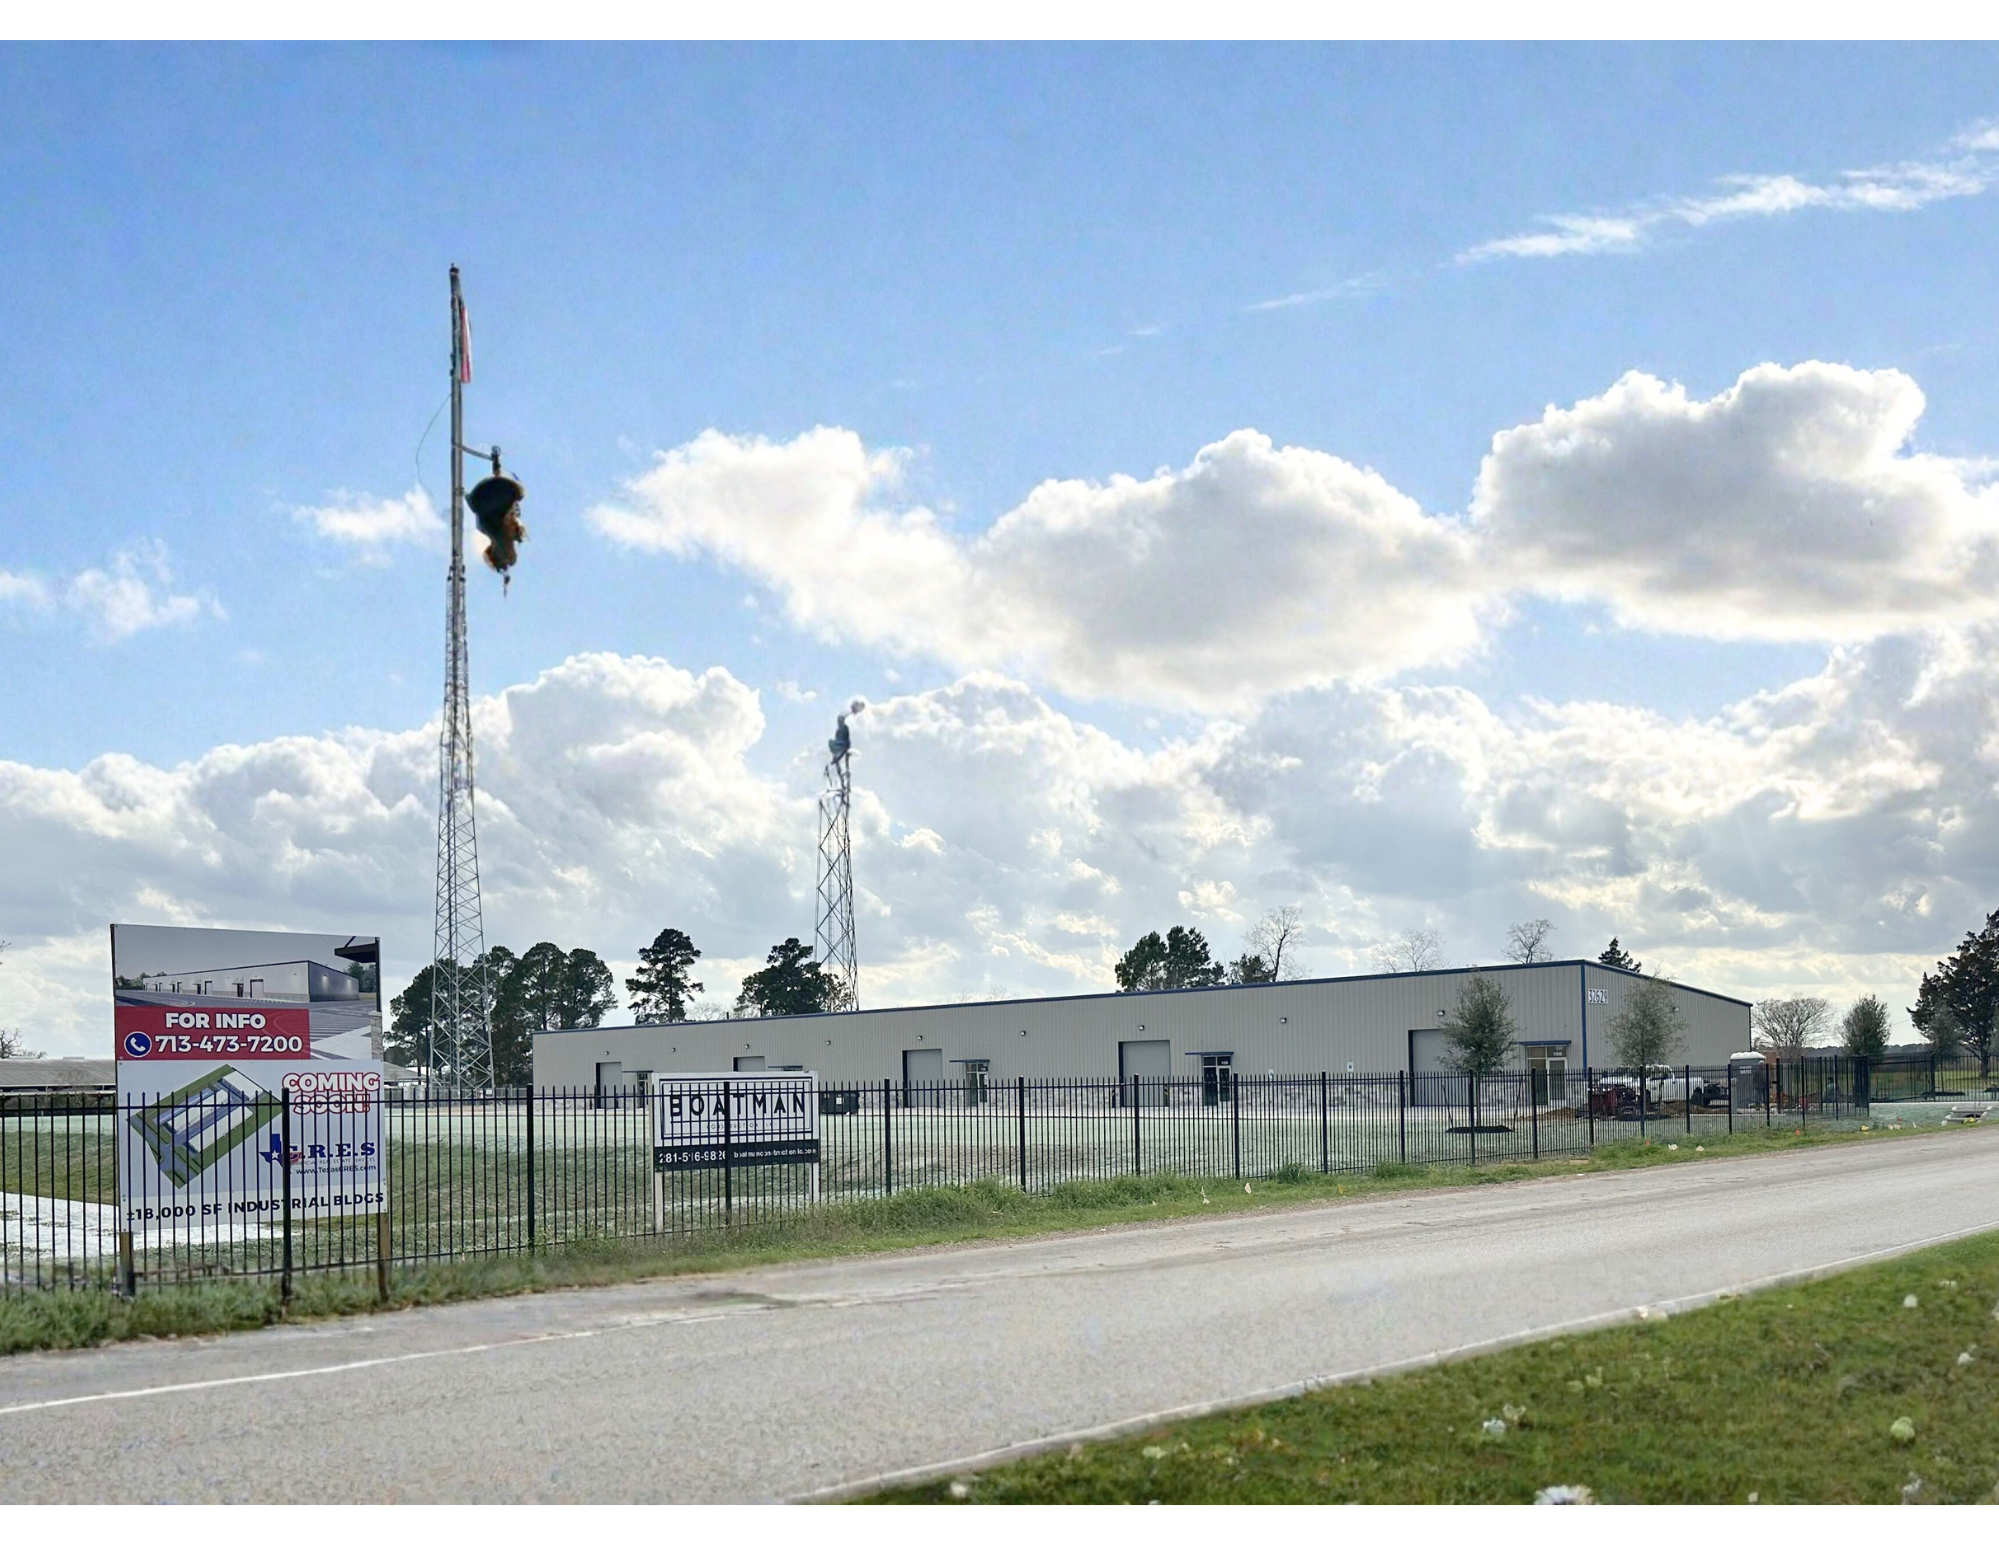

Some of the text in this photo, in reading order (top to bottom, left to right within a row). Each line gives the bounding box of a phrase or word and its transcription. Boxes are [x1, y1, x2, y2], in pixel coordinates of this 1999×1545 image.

[1589, 989, 1607, 1003] 32629
[165, 1012, 266, 1029] FOR INFO
[154, 1035, 302, 1053] 713-473-7200
[282, 1072, 381, 1093] COMING
[293, 1094, 371, 1115] SOON!
[669, 1094, 805, 1117] BOATMAN
[201, 1203, 223, 1215] SF
[228, 1197, 331, 1213] INDUSRIAL
[333, 1192, 385, 1206] BLDGS
